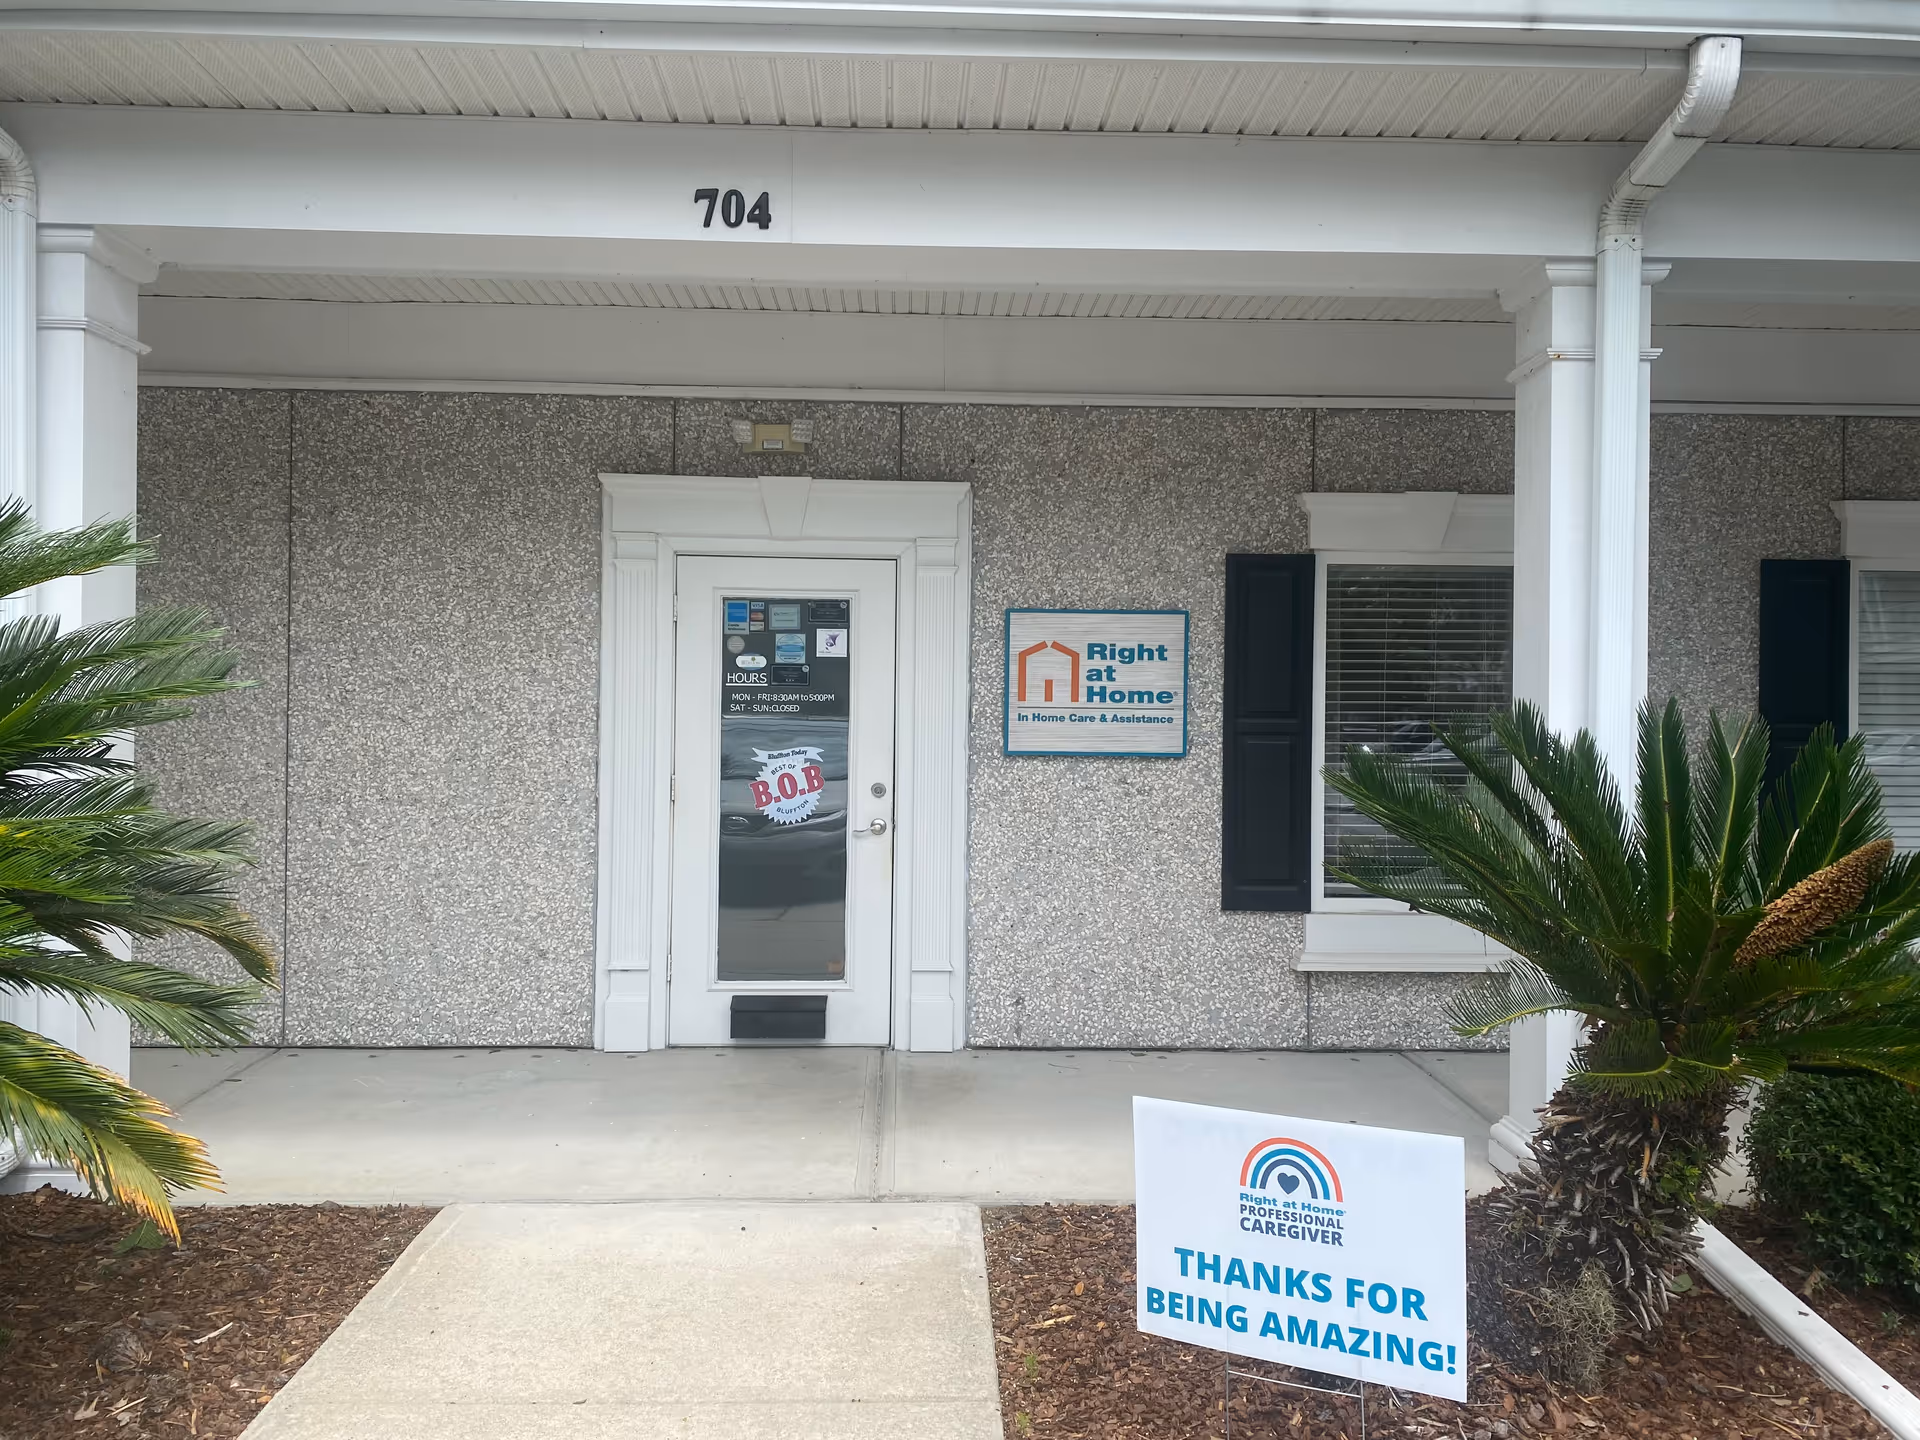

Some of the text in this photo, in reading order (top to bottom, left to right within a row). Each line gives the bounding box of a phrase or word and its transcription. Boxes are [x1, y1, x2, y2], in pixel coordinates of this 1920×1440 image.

[694, 188, 771, 230] 704
[1087, 643, 1168, 664] Right
[727, 672, 767, 683] HOURS
[1086, 665, 1116, 682] at
[732, 693, 751, 701] MON
[730, 703, 746, 712] SAT
[1017, 712, 1174, 724] In Home Care & Assistance
[767, 752, 791, 760] Bluffton
[770, 763, 786, 775] BEST
[749, 765, 825, 809] B.O.B
[776, 799, 809, 814] BLUFFTON
[1239, 1192, 1344, 1216] Right at Home
[1240, 1204, 1344, 1230] PROFESSIONAL
[1240, 1217, 1344, 1247] CAREGIVER
[1174, 1247, 1428, 1321] THANKS FOR
[1146, 1286, 1457, 1375] BEING AMAZING!
